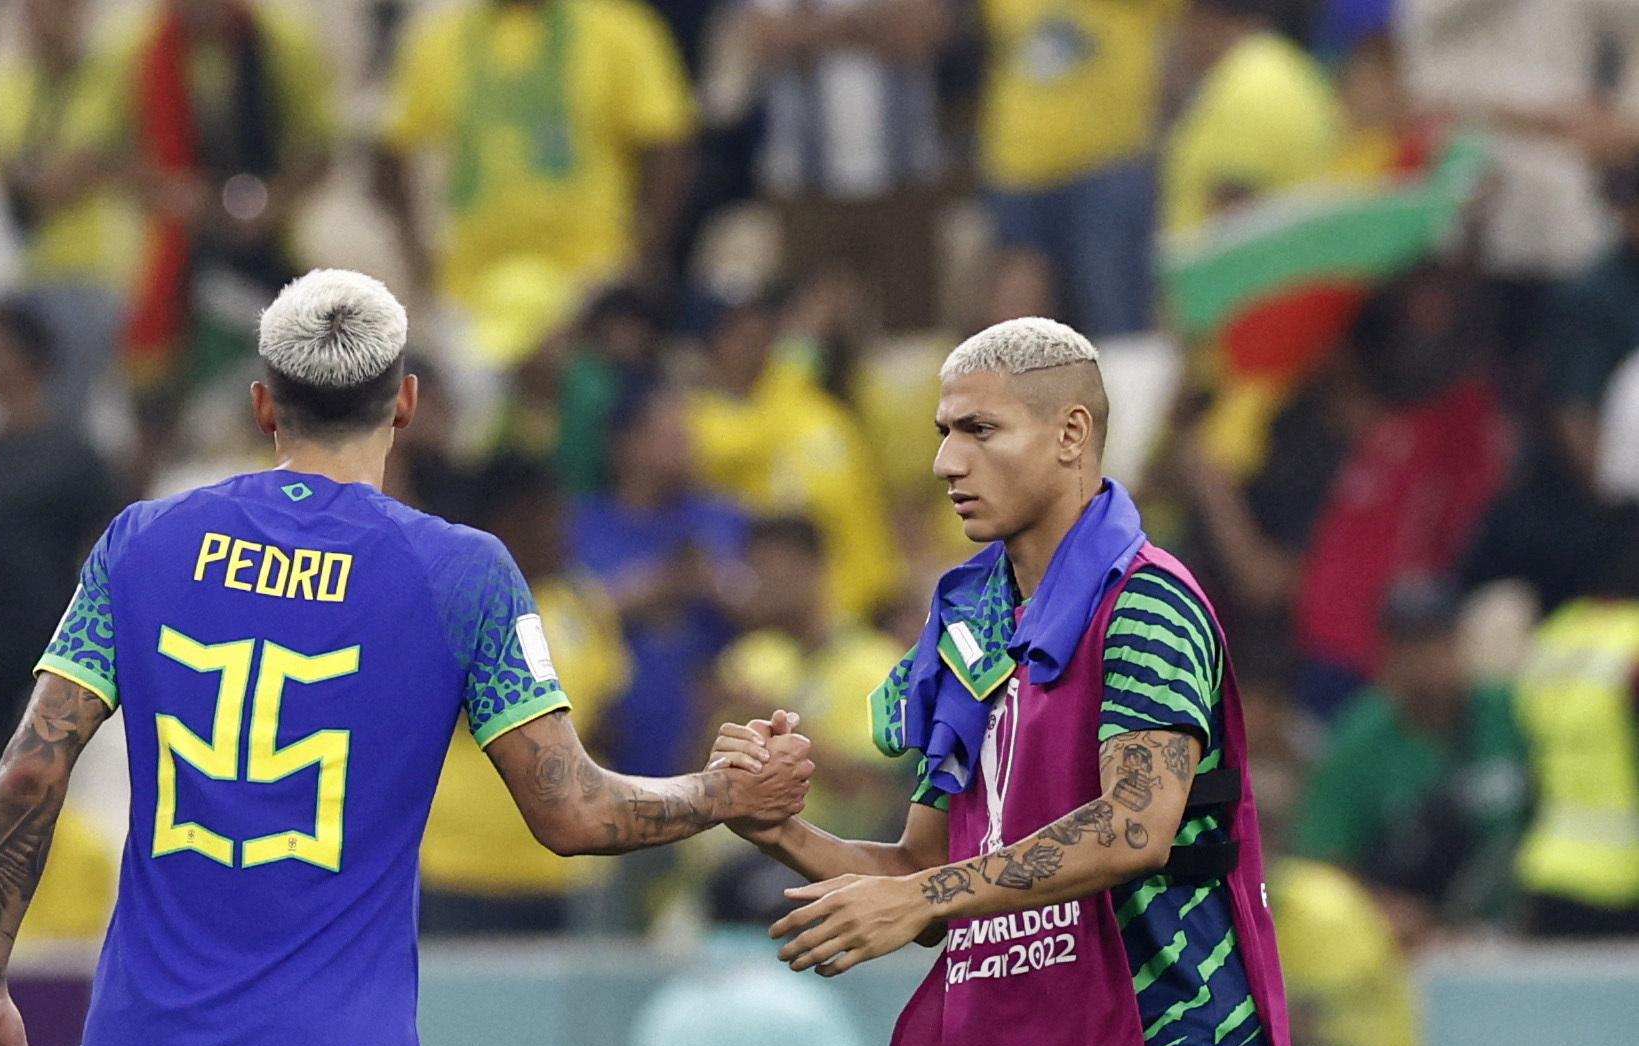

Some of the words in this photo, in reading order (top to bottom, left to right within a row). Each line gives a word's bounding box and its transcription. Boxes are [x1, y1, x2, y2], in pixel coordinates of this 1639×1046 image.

[194, 532, 353, 602] PEDRO
[152, 625, 360, 872] 25
[947, 928, 972, 953] IFA
[1042, 900, 1081, 930] CUP
